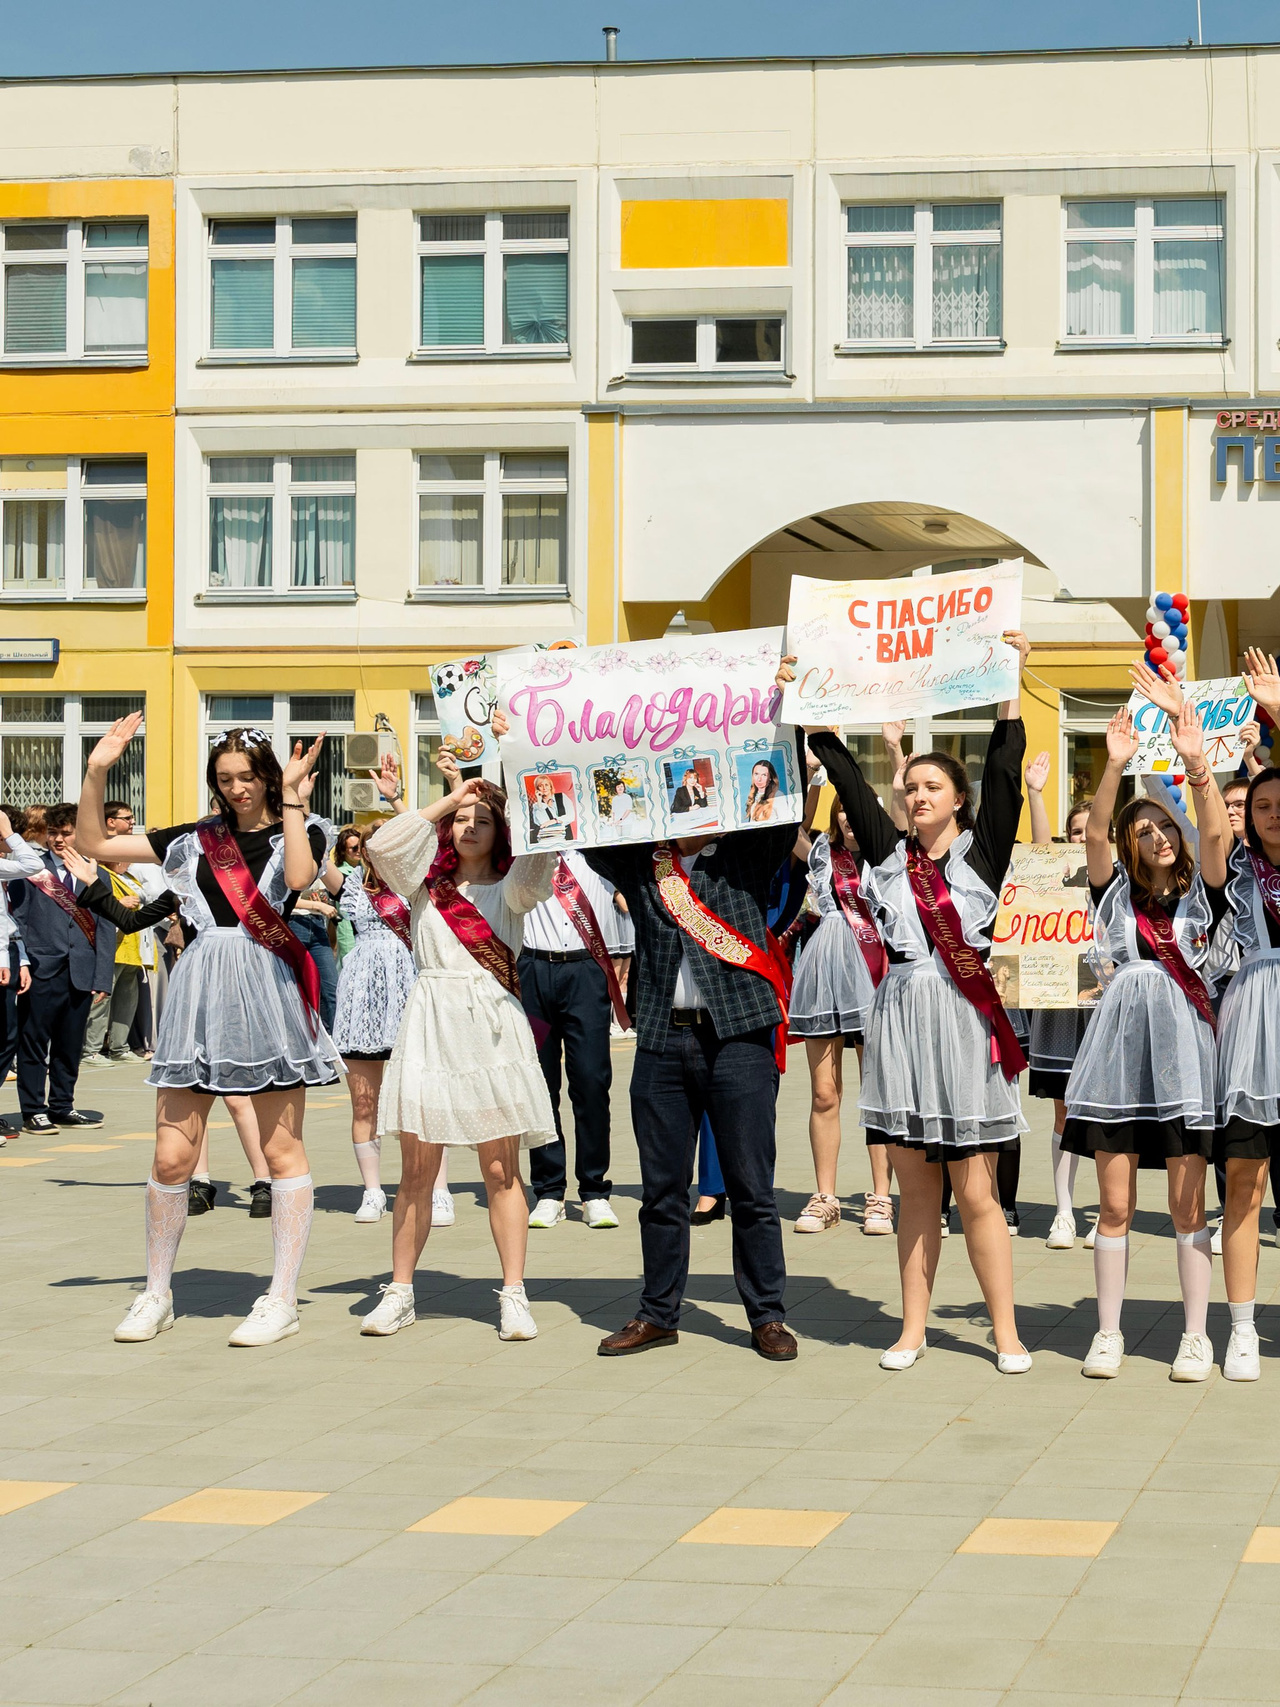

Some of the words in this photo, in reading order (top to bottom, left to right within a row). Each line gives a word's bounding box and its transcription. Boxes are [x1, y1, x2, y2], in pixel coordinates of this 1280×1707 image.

[848, 586, 993, 629] СПАСИБО
[876, 628, 934, 663] ВАМ
[798, 667, 905, 700] Светлана
[907, 647, 1018, 691] Николаевна
[917, 858, 958, 949] Выпускница
[950, 949, 985, 978] 2025
